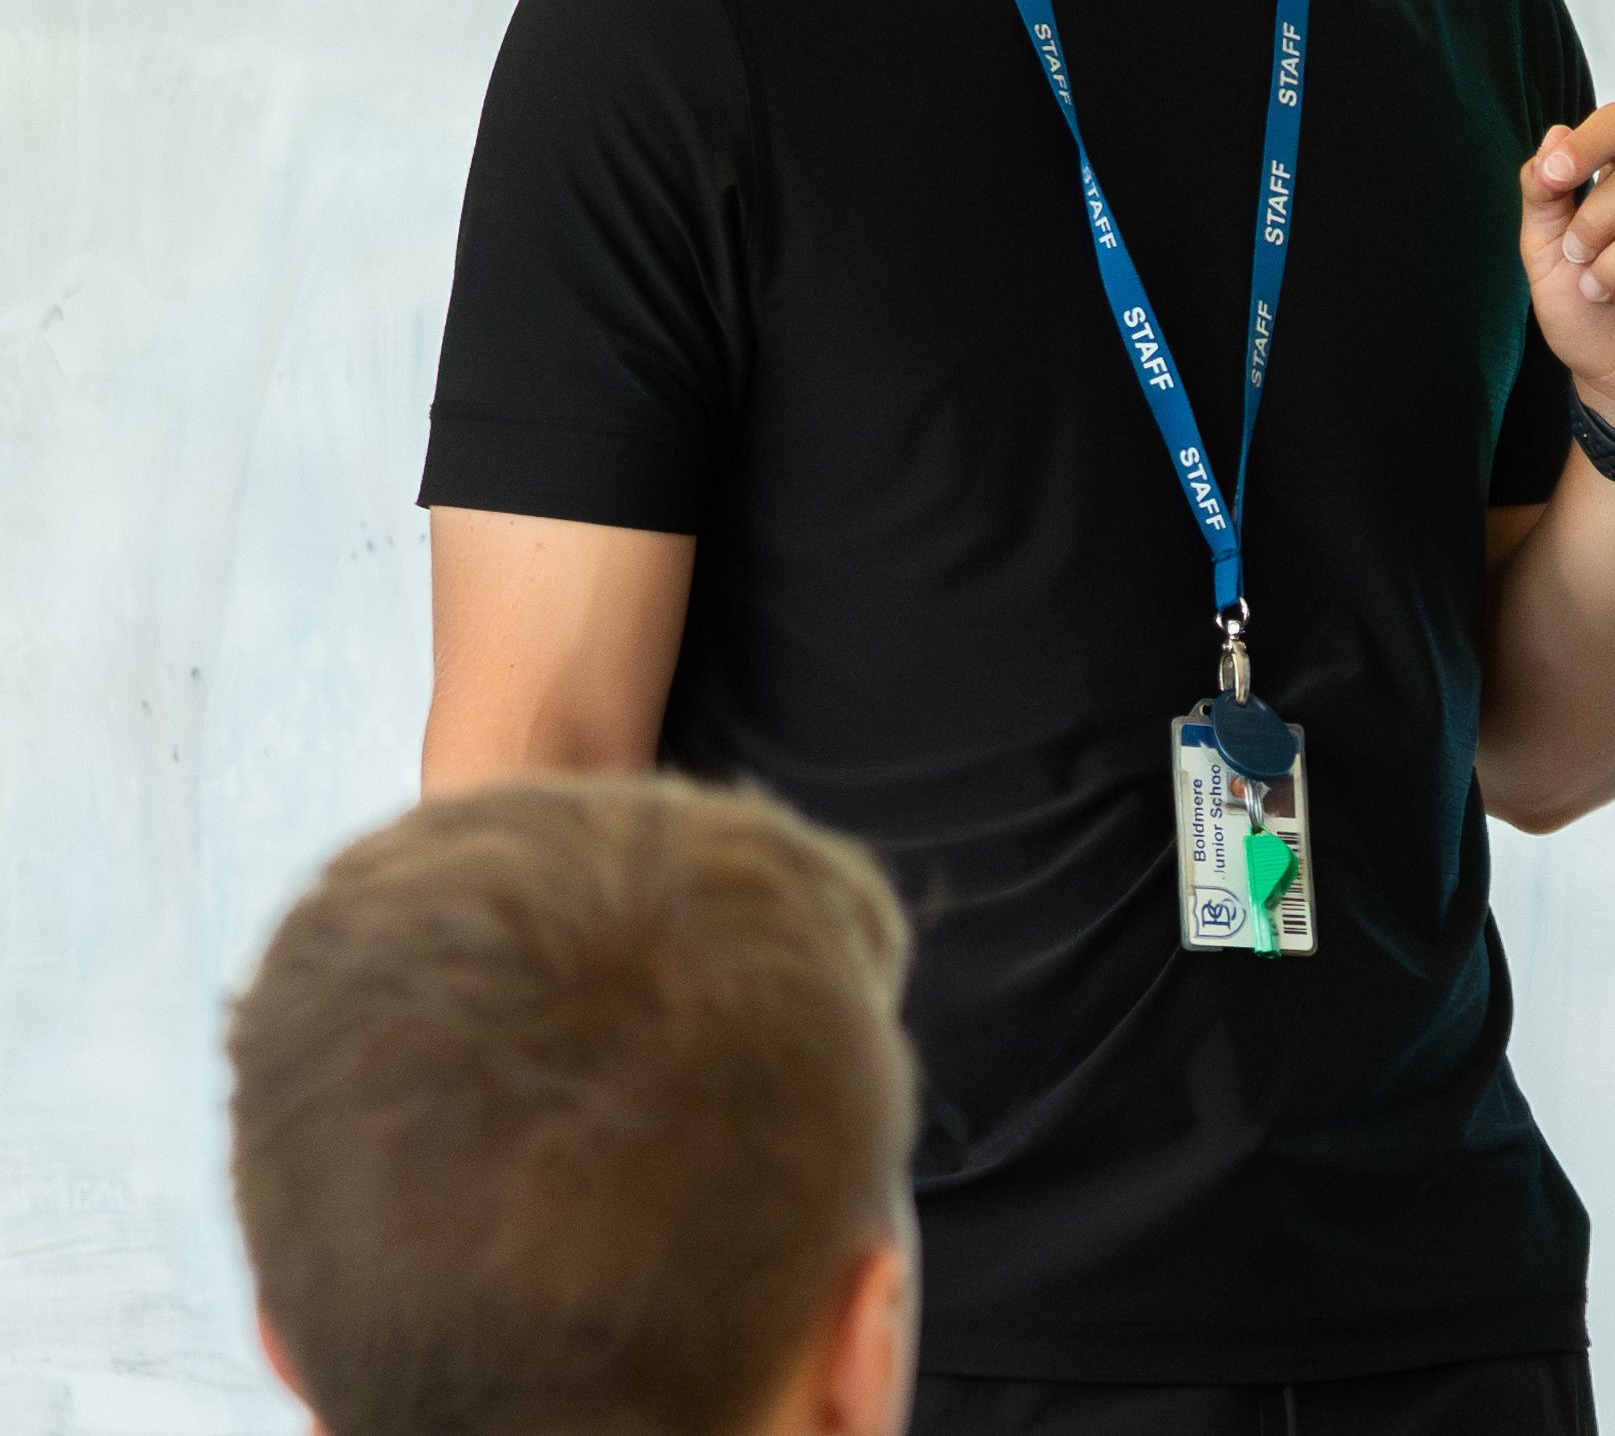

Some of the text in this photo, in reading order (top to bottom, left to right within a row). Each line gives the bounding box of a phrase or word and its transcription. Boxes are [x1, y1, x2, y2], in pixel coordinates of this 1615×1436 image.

[1033, 23, 1071, 104] STAFF
[1277, 21, 1301, 107] STAFF
[1264, 159, 1291, 246] STAFF
[1123, 306, 1175, 391] STAFF
[1250, 299, 1273, 388] STAFF
[1179, 446, 1227, 530] STAFF
[1193, 778, 1207, 863] Boldmere
[1210, 763, 1224, 819] Schoo
